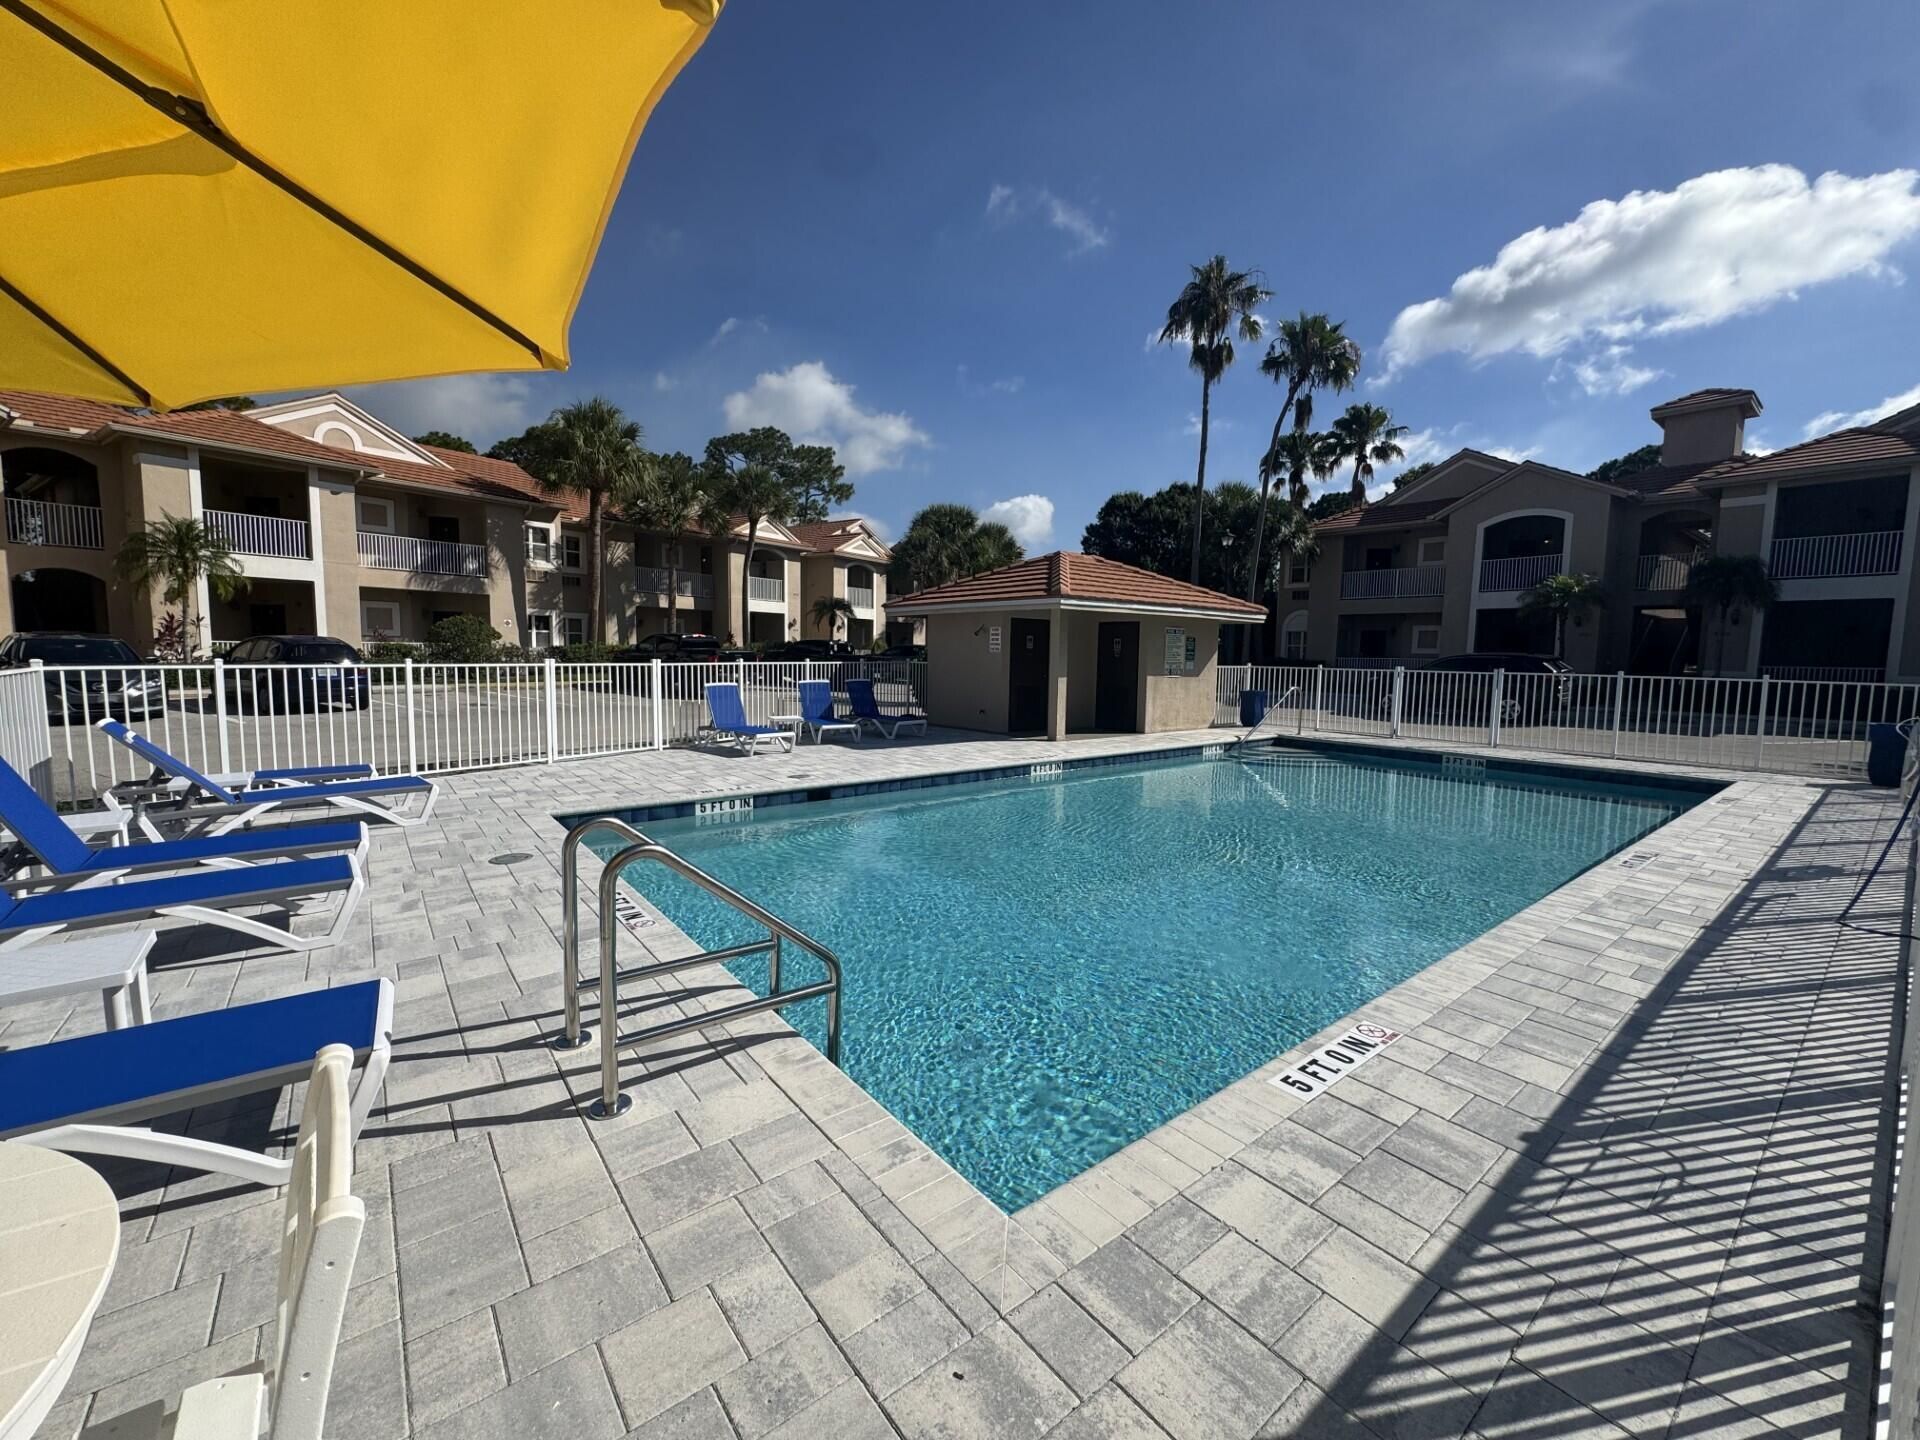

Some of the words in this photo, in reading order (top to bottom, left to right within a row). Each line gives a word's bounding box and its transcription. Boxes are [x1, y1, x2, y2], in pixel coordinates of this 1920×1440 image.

[700, 802, 706, 814] 5
[729, 799, 736, 810] 0
[1337, 1035, 1380, 1055] IN.
[1325, 1049, 1355, 1065] 0
[1297, 1058, 1342, 1083] FT.
[1280, 1074, 1314, 1093] 5
